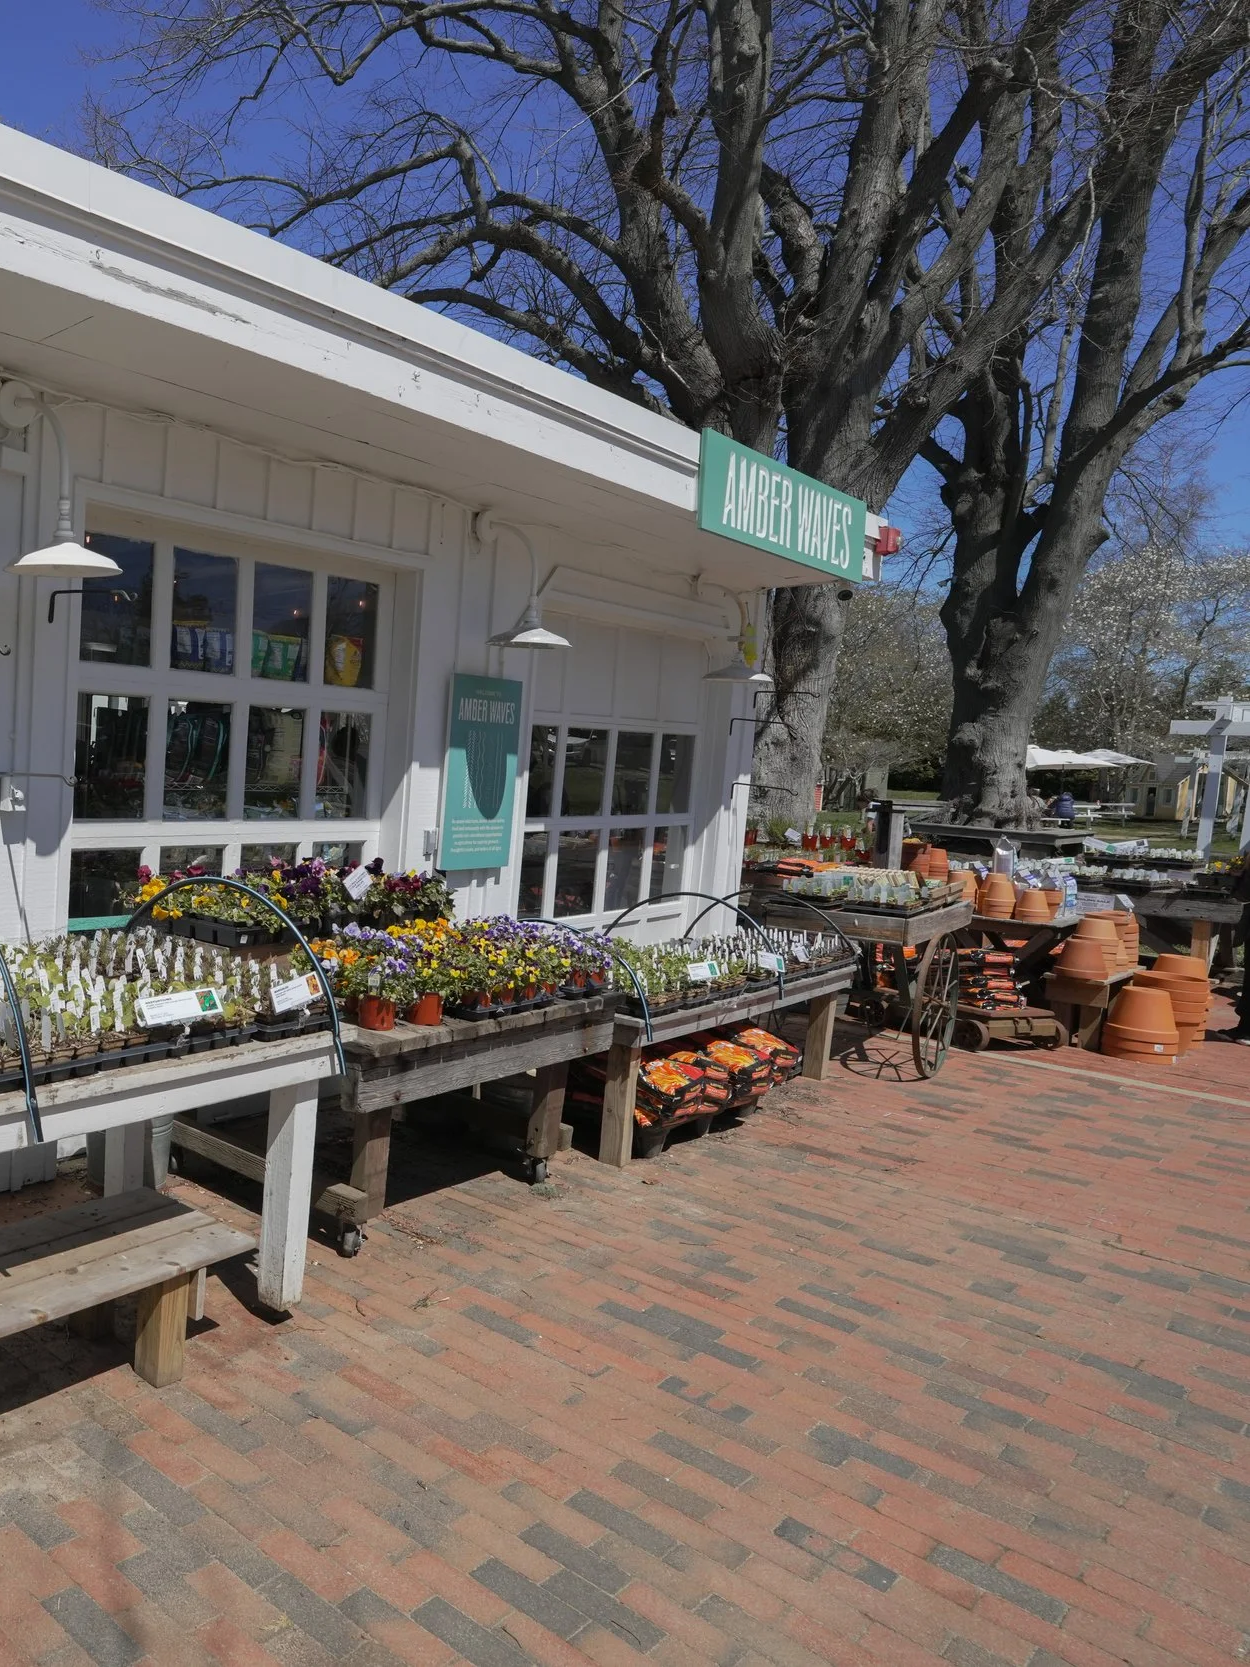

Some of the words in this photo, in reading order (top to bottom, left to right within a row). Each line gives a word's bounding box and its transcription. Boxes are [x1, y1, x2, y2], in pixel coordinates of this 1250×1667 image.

[722, 452, 792, 548] AMBER
[798, 484, 852, 570] WAVES
[458, 697, 488, 722] AMBER
[490, 700, 516, 725] WAVES
